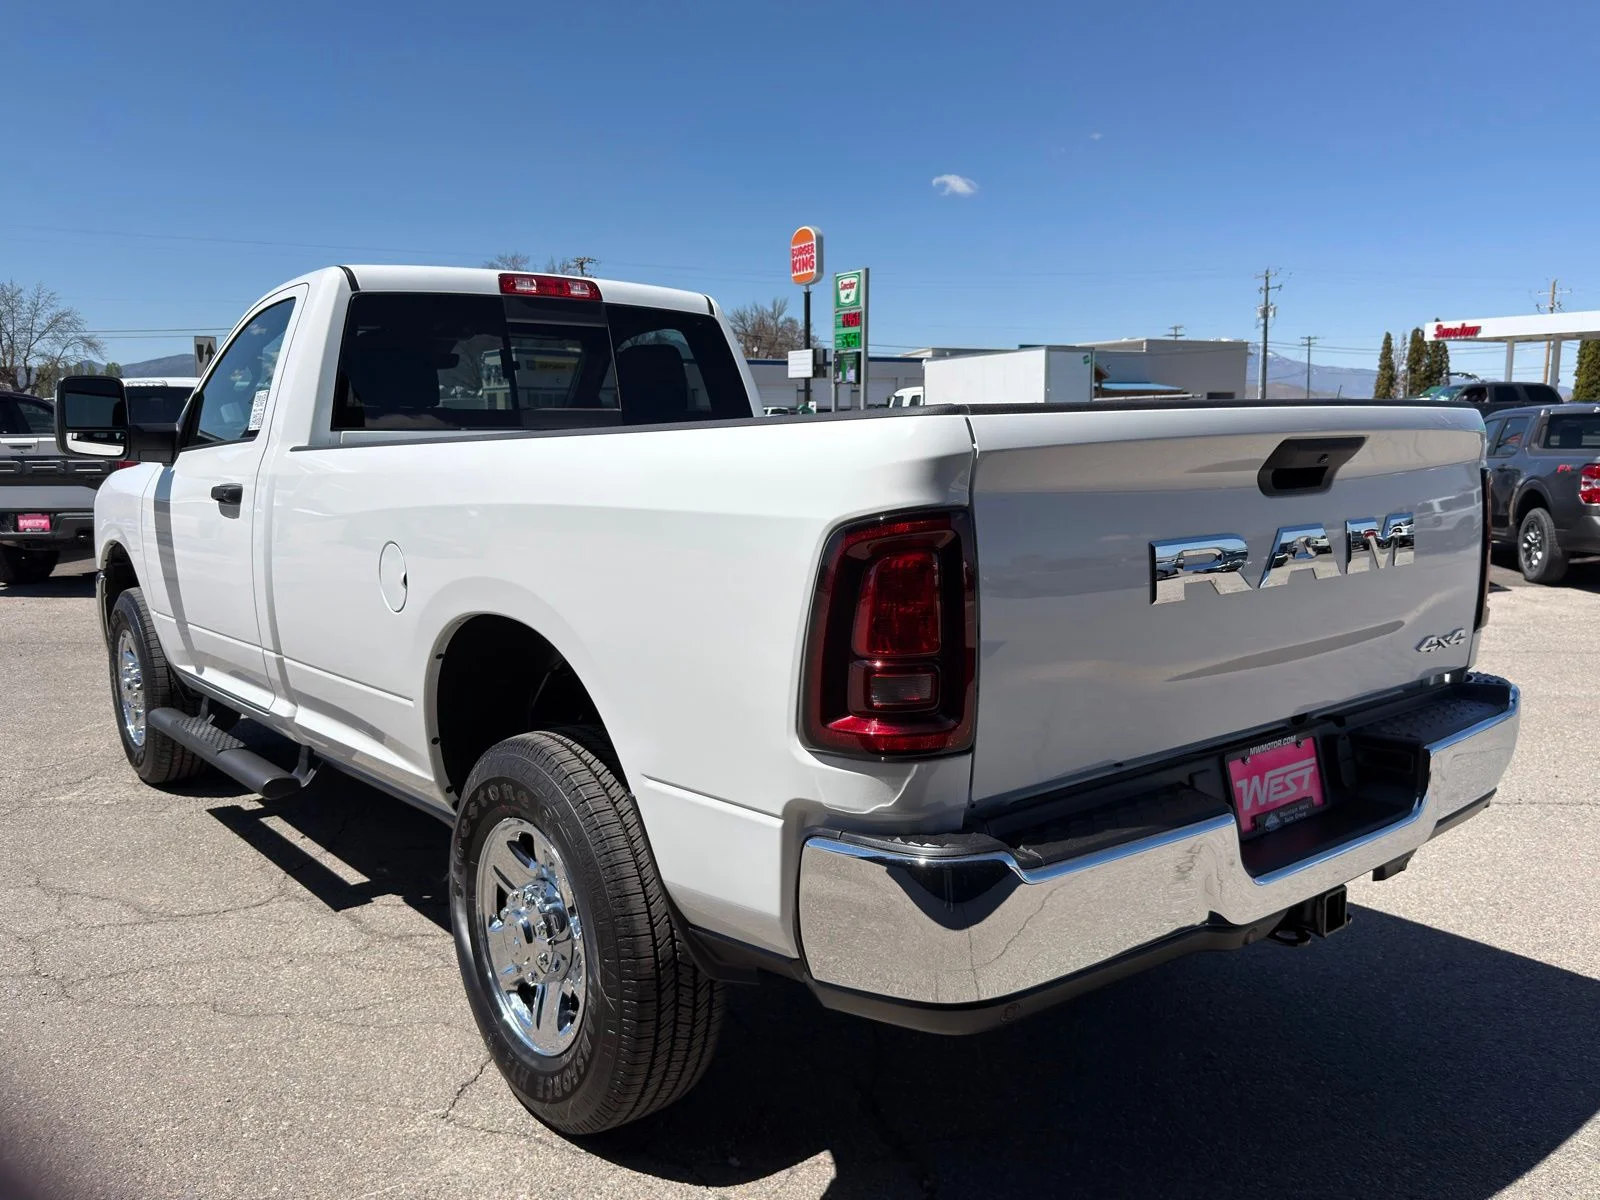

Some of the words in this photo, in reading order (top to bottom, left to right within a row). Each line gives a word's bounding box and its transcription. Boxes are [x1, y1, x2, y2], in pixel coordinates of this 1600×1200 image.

[791, 254, 815, 274] KING
[1149, 512, 1415, 605] RAM
[1236, 757, 1317, 811] WEST
